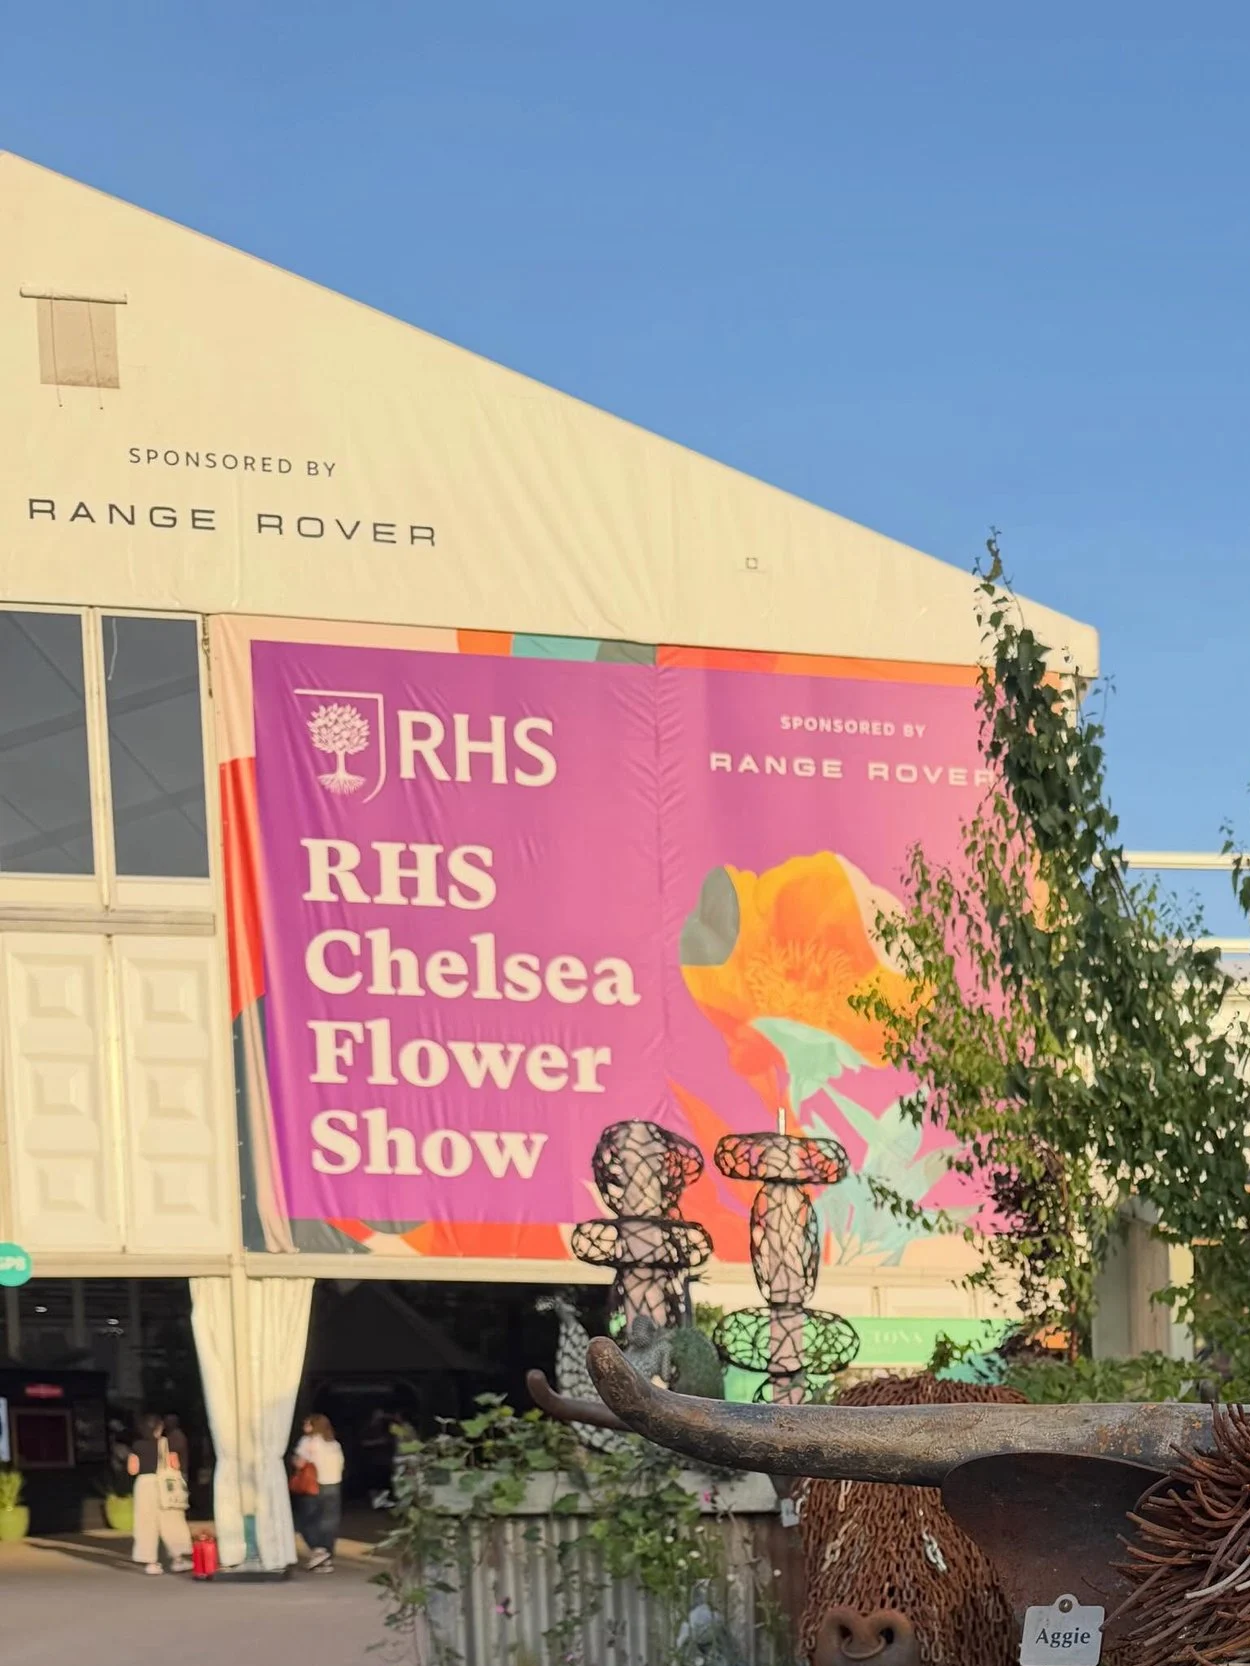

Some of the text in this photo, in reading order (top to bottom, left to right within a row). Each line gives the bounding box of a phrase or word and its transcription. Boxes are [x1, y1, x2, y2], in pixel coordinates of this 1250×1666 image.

[128, 447, 337, 478] SPONSORED BY
[28, 498, 436, 547] RANGE ROVER
[396, 709, 558, 788] RHS
[779, 714, 926, 739] SPONSORED BY
[708, 751, 996, 789] RANGE ROVER
[300, 837, 497, 911] RHS
[304, 927, 642, 1007] Chelsea
[306, 1017, 612, 1094] Flower
[309, 1106, 549, 1180] Show
[1035, 1627, 1091, 1649] Aggie
